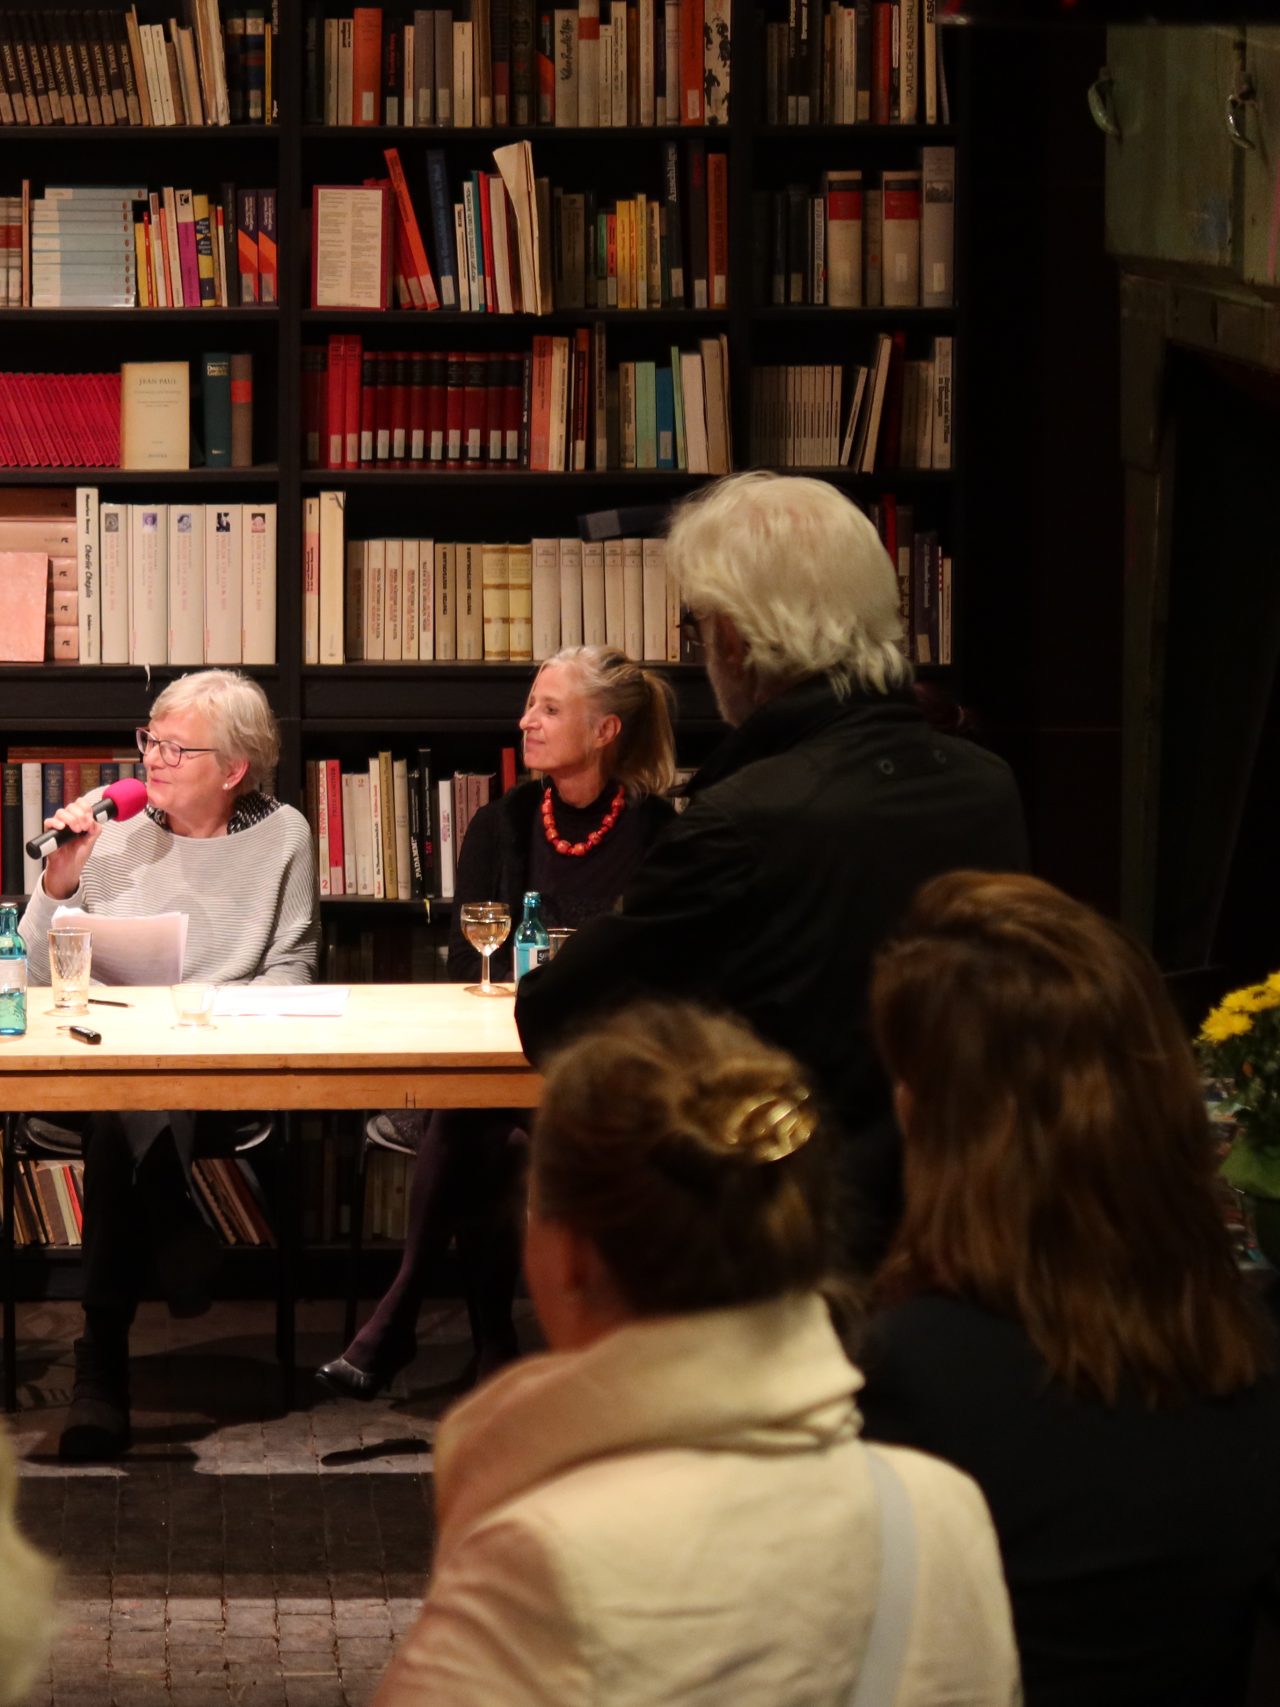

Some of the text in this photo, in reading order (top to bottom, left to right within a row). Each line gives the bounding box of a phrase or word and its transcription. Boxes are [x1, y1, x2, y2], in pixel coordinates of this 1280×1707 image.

[667, 146, 678, 203] Anschläge
[138, 378, 157, 386] JEAN
[84, 544, 93, 570] Charlie
[84, 571, 94, 598] Chaplin
[322, 879, 328, 890] 2
